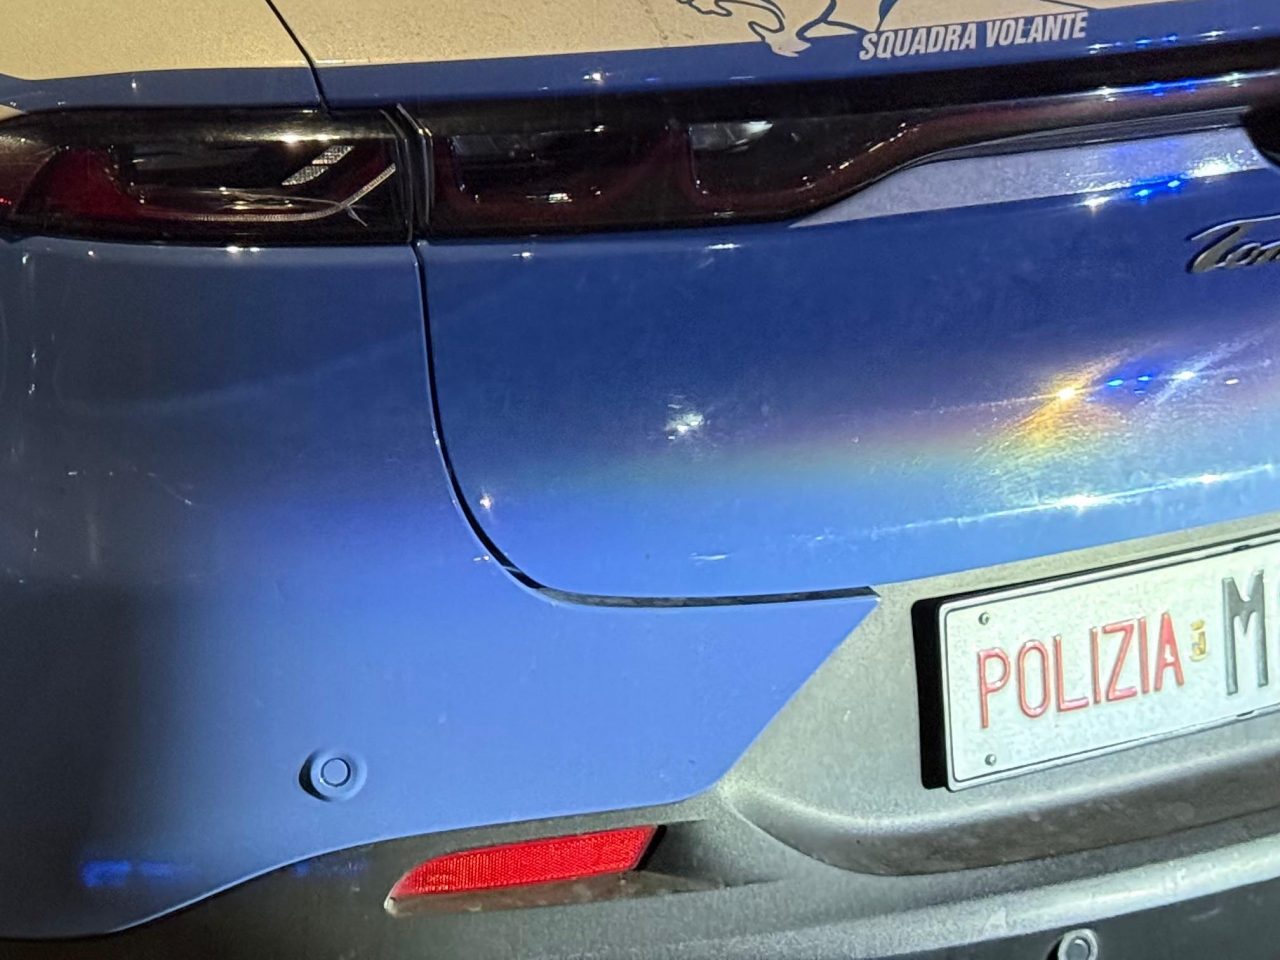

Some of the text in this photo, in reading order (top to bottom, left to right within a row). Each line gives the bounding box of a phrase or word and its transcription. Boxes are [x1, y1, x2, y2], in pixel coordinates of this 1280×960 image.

[858, 11, 1089, 61] SQUADRA VOLANTE
[977, 569, 1280, 730] POLIZIA M
